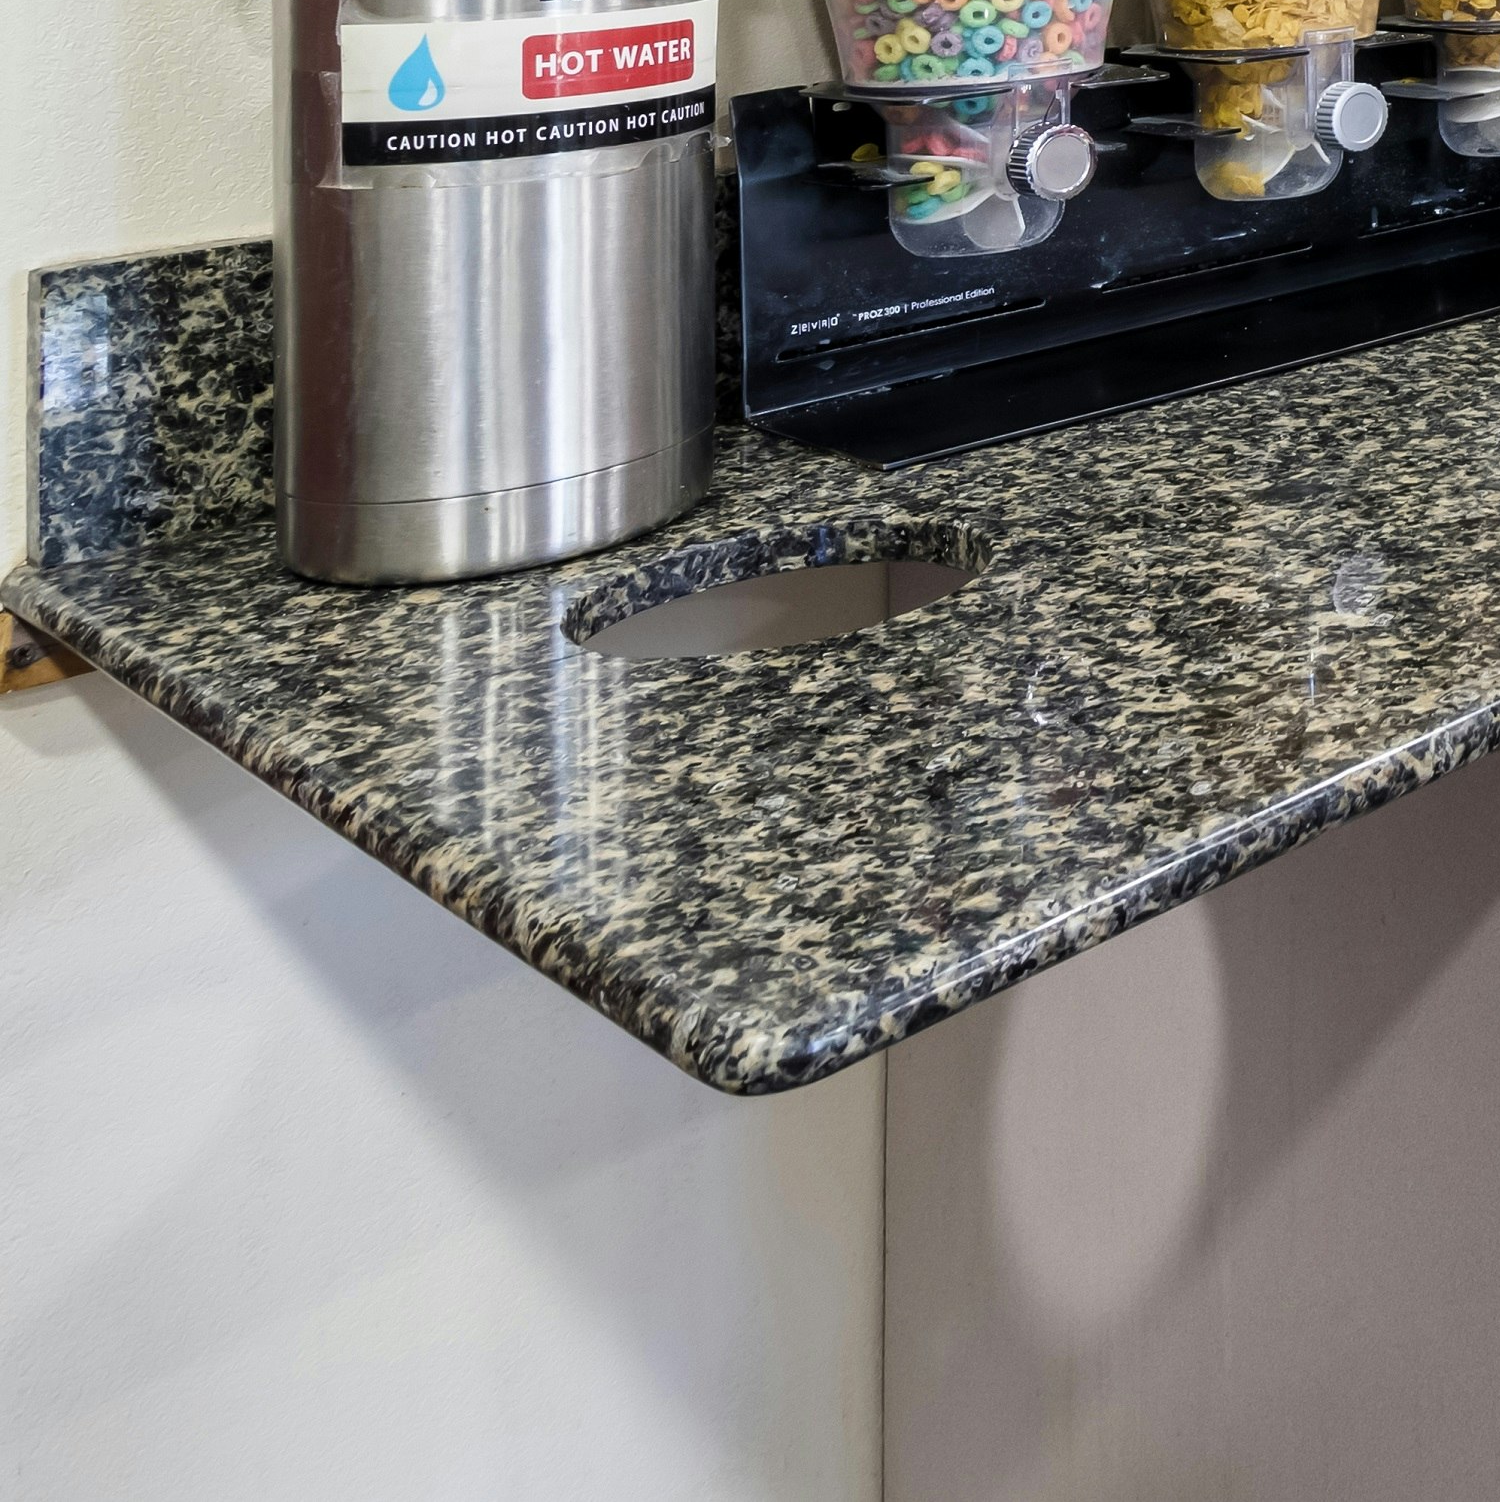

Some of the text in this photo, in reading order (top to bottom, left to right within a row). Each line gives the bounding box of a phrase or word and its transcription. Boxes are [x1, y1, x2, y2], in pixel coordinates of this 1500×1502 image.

[535, 37, 691, 78] HOT WATER
[386, 101, 705, 151] CAUTION HOT CAUTION HOT CAUTION
[911, 292, 964, 311] Professional
[965, 286, 995, 301] Edition
